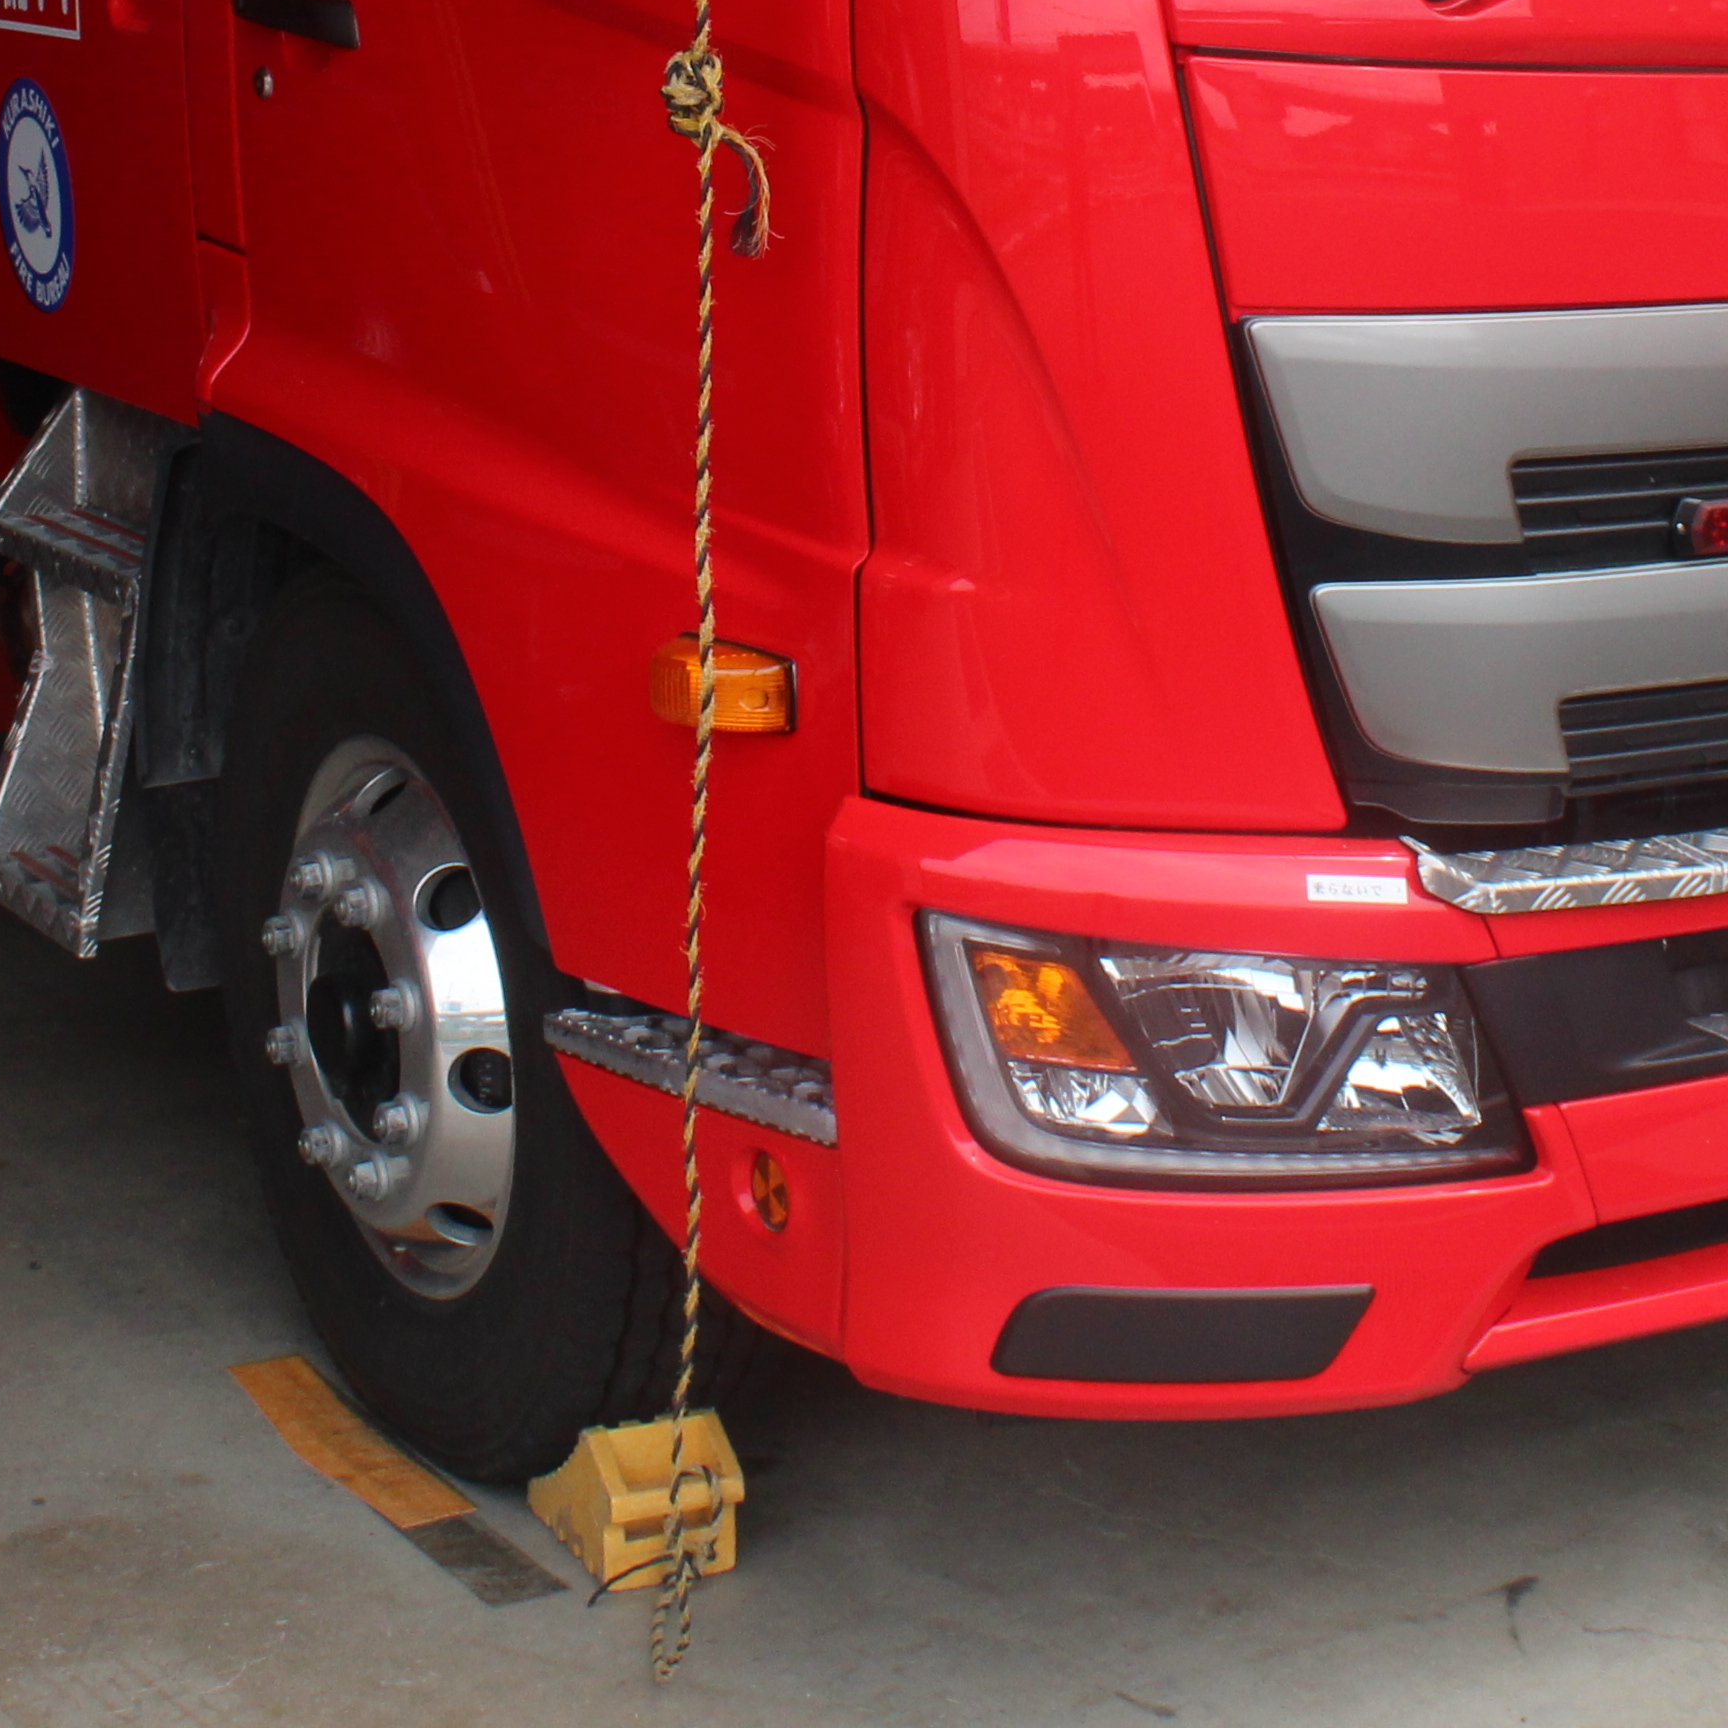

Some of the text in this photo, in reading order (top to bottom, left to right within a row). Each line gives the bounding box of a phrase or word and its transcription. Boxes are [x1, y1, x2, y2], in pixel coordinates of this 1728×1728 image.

[2, 86, 60, 150] KURASHIKI
[9, 240, 70, 308] FIRE BUREAU
